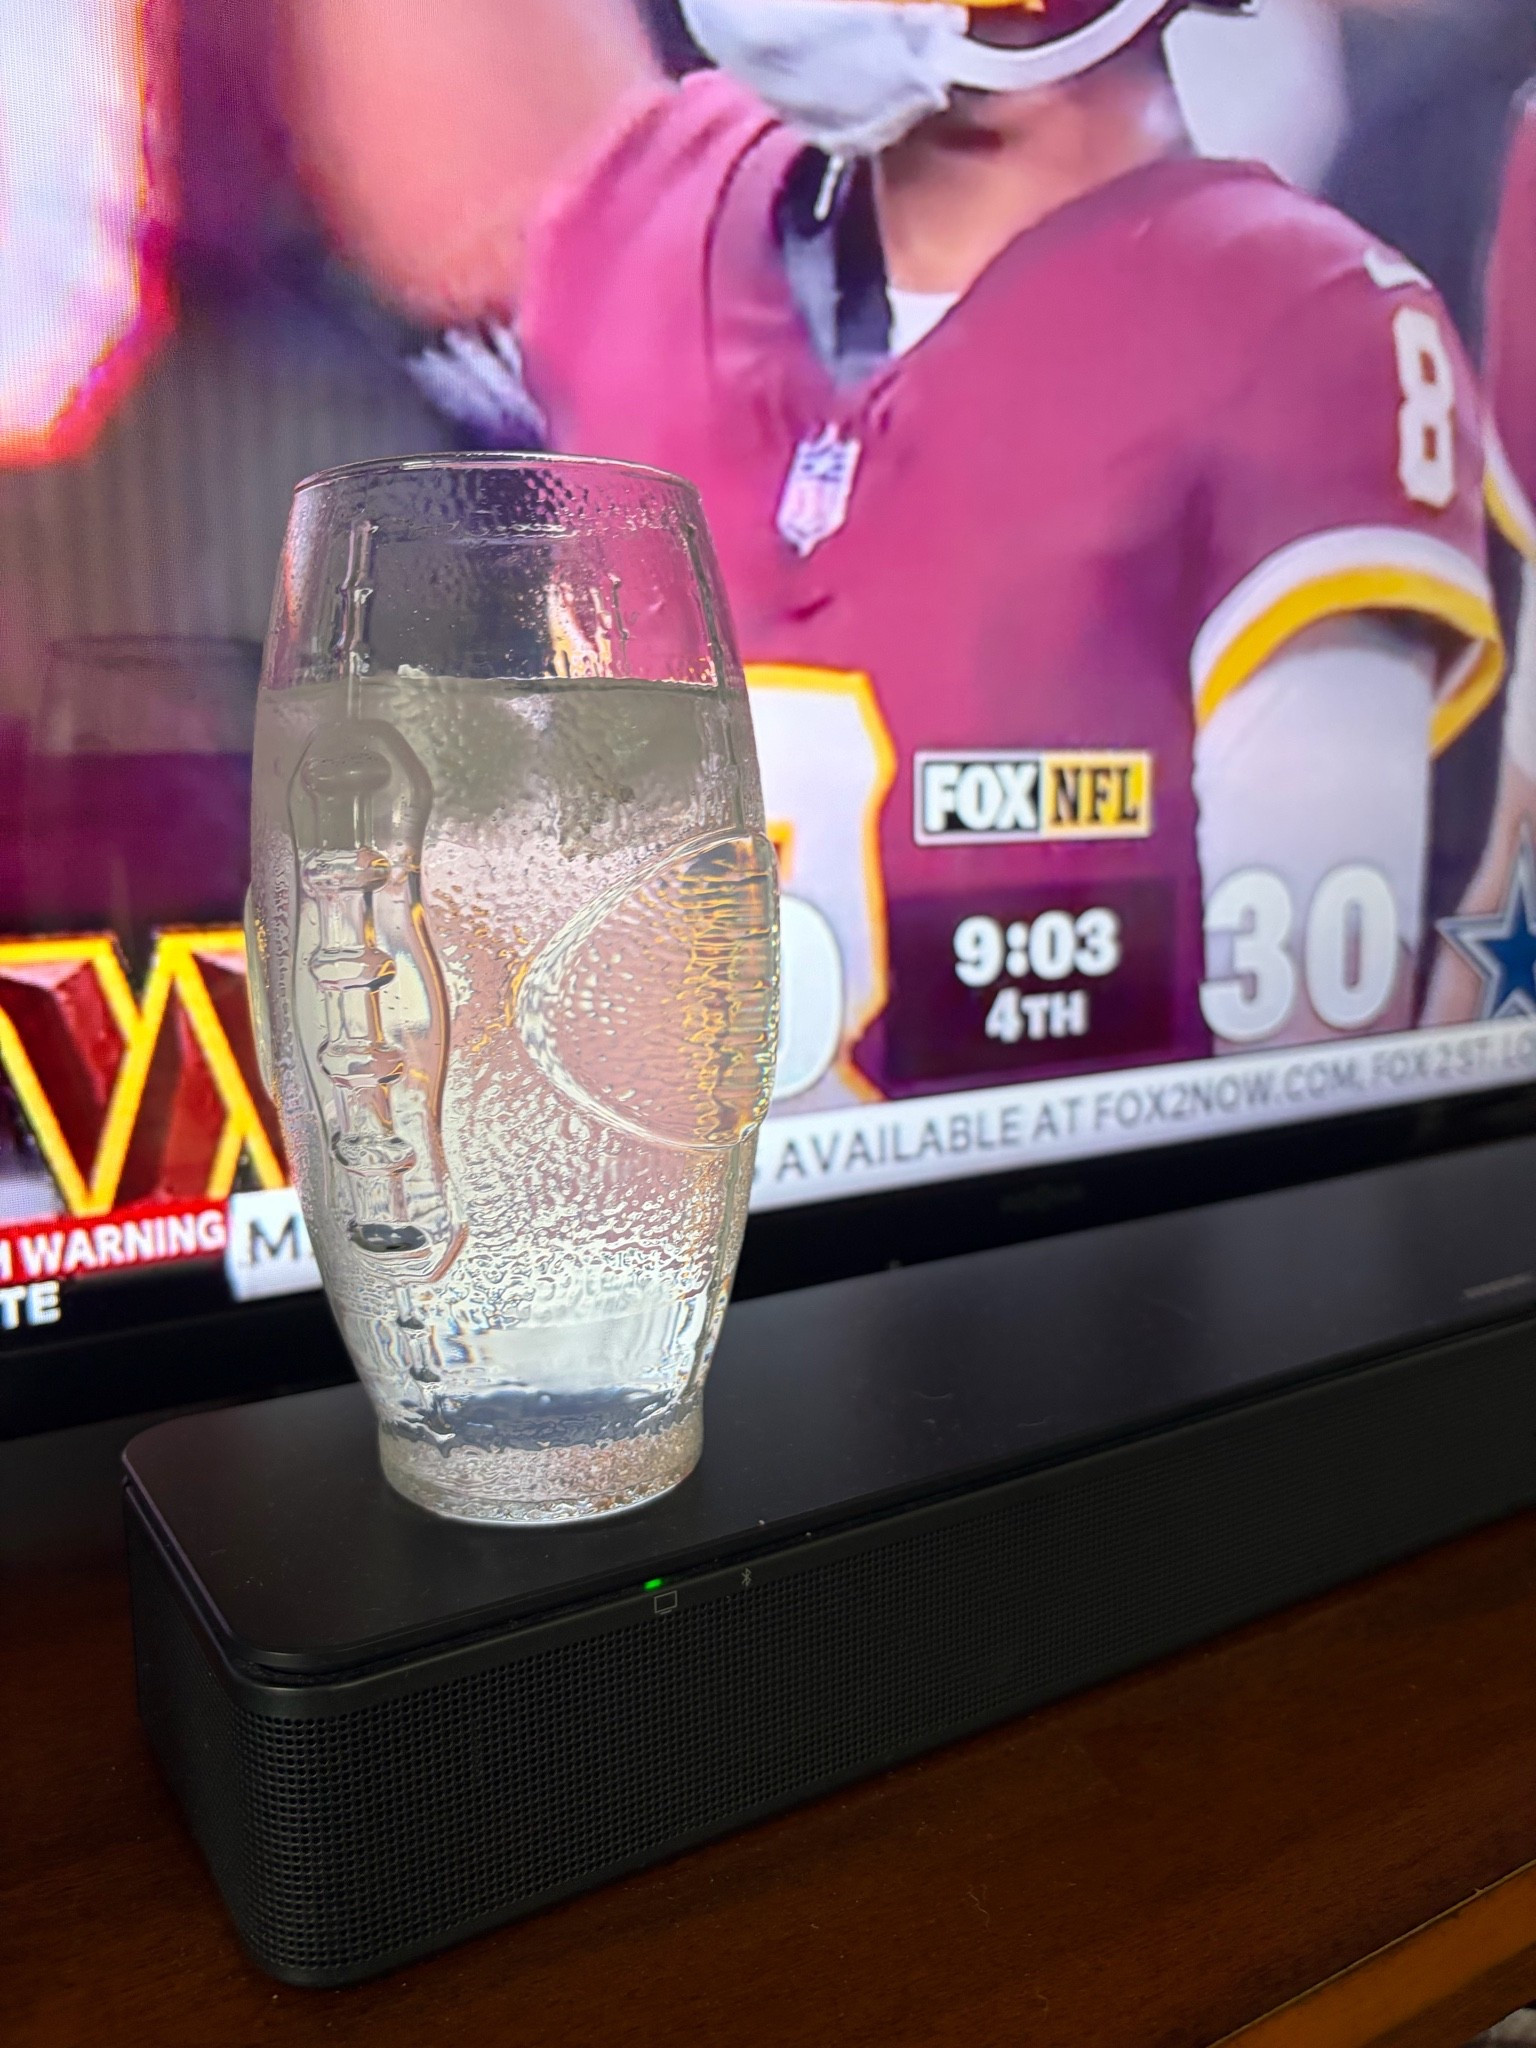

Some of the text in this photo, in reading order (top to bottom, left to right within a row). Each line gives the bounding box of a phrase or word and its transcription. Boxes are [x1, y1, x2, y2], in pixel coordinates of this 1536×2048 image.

[1393, 306, 1454, 508] 8
[922, 762, 1138, 834] FOX NFL
[952, 907, 1121, 988] 9:03
[1200, 864, 1396, 1042] 30
[984, 986, 1088, 1044] 4TH
[775, 1103, 1023, 1183] AVAILABLE
[1031, 1097, 1086, 1143] AT
[20, 1209, 228, 1278] WARNING
[248, 1214, 314, 1267] M
